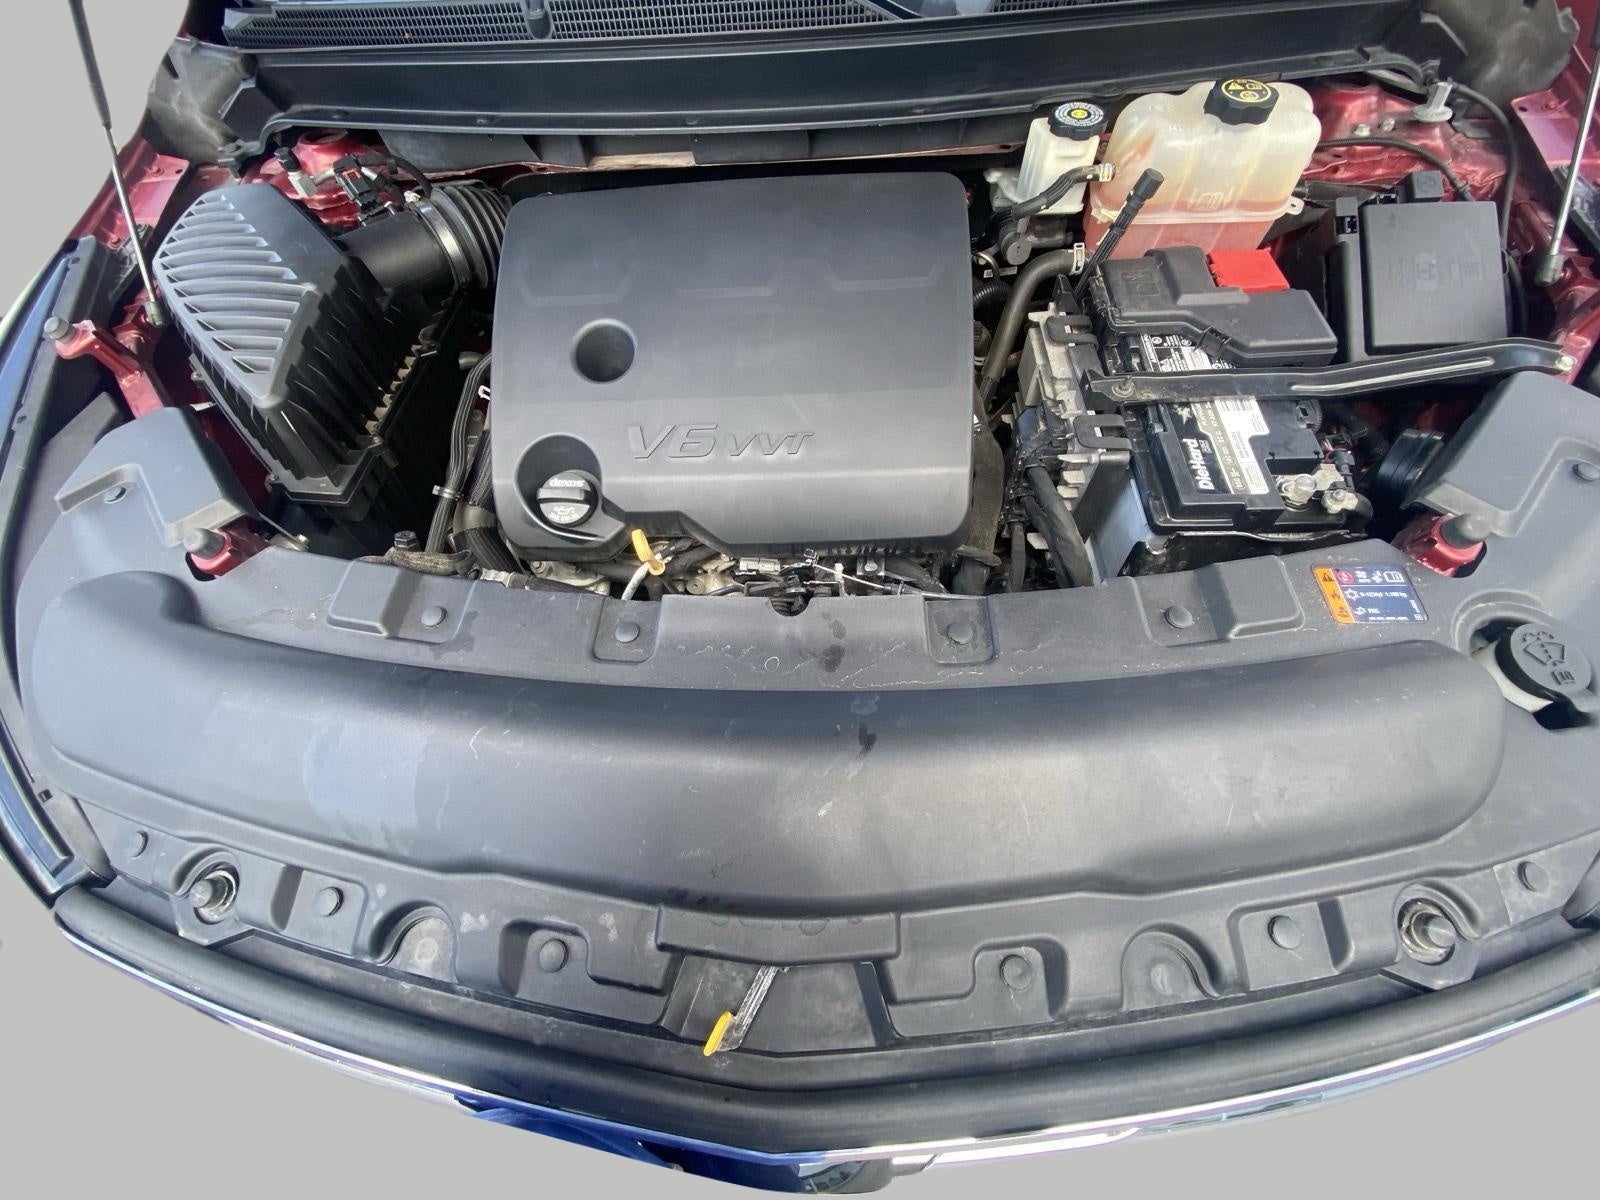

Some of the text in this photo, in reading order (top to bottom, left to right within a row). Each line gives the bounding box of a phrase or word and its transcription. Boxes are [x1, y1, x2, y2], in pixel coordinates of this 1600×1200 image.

[628, 424, 815, 459] V6 VVT
[1182, 438, 1215, 490] DieHard
[550, 478, 585, 487] dexos
